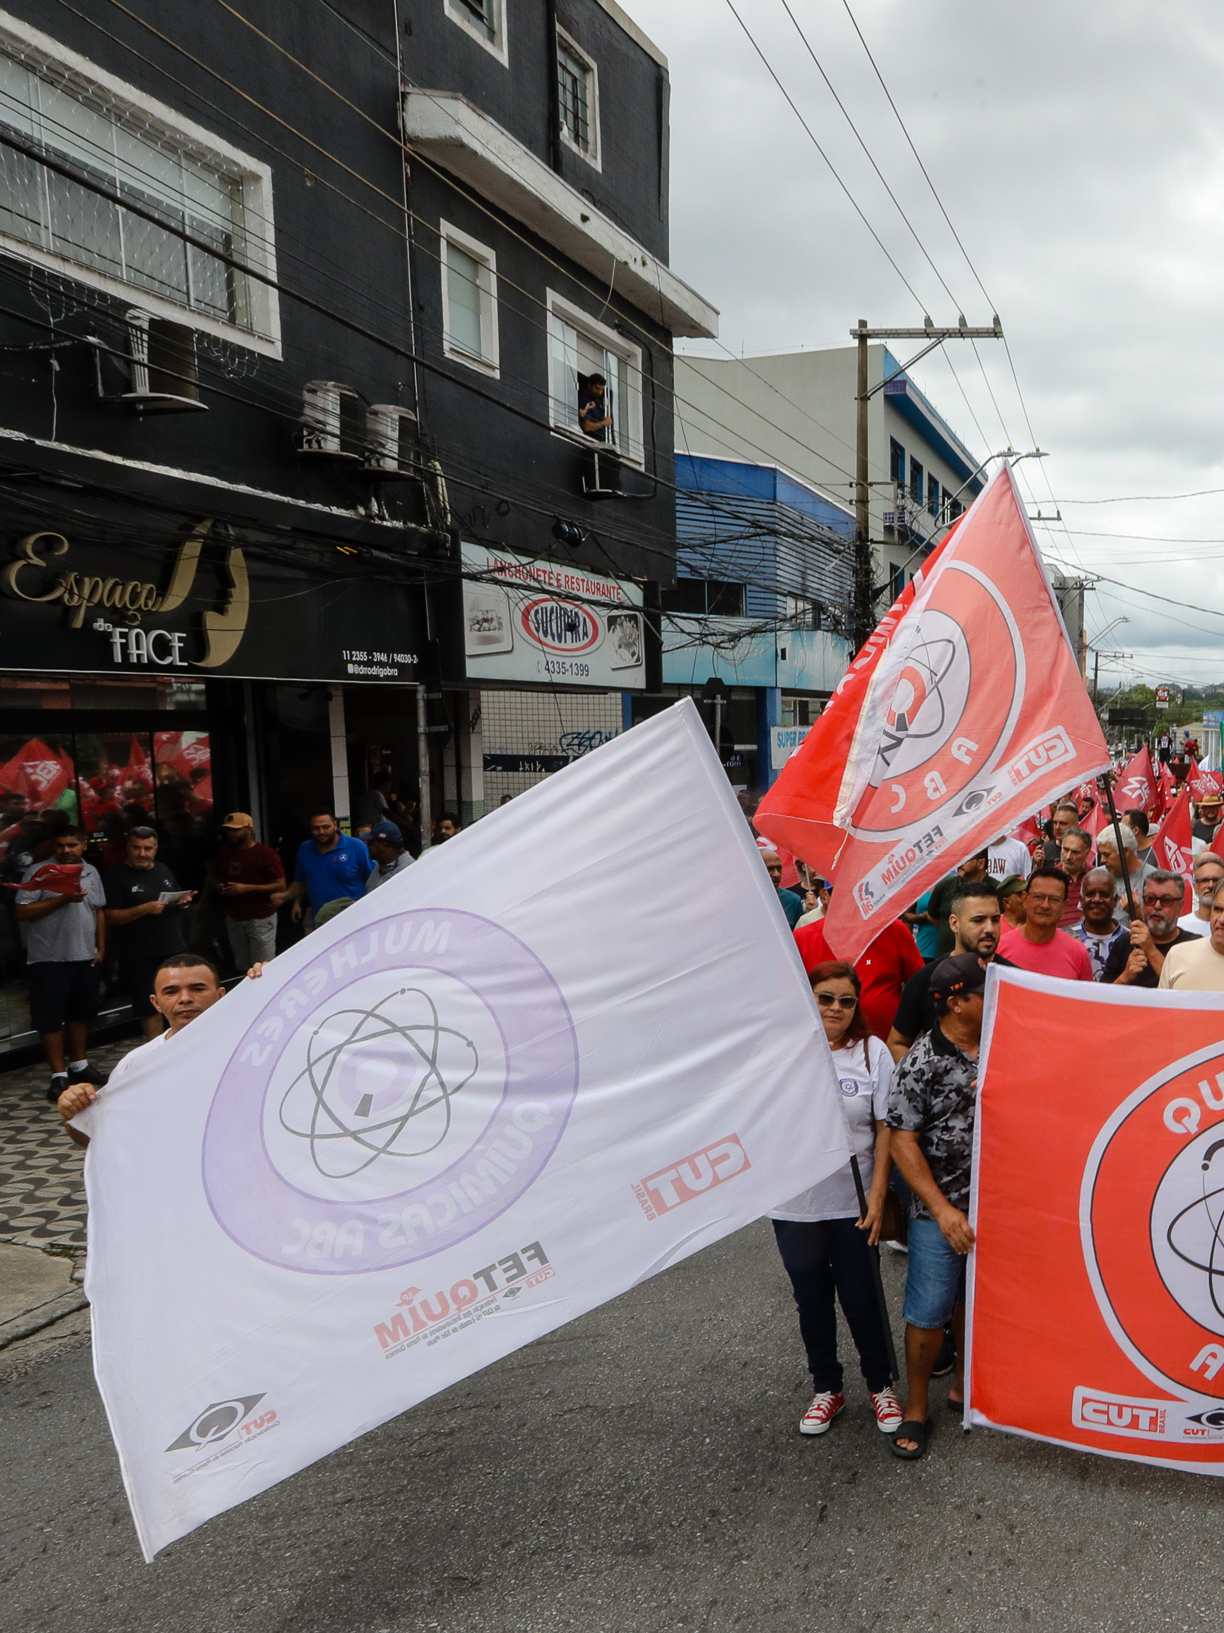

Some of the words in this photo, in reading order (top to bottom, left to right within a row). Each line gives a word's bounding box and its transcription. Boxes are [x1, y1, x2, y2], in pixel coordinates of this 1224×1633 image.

[5, 531, 163, 629] Espaço
[486, 557, 554, 587] LANCHONETE
[556, 570, 563, 588] E
[564, 574, 622, 601] RESTAURANTE
[534, 606, 589, 645] SUCUPIRA
[110, 627, 189, 666] FACE
[544, 660, 589, 677] 4335-1399
[777, 731, 797, 748] SUPER
[1082, 1401, 1157, 1431] CUT
[1158, 1408, 1167, 1434] BRASIL
[1183, 1428, 1208, 1436] CUT
